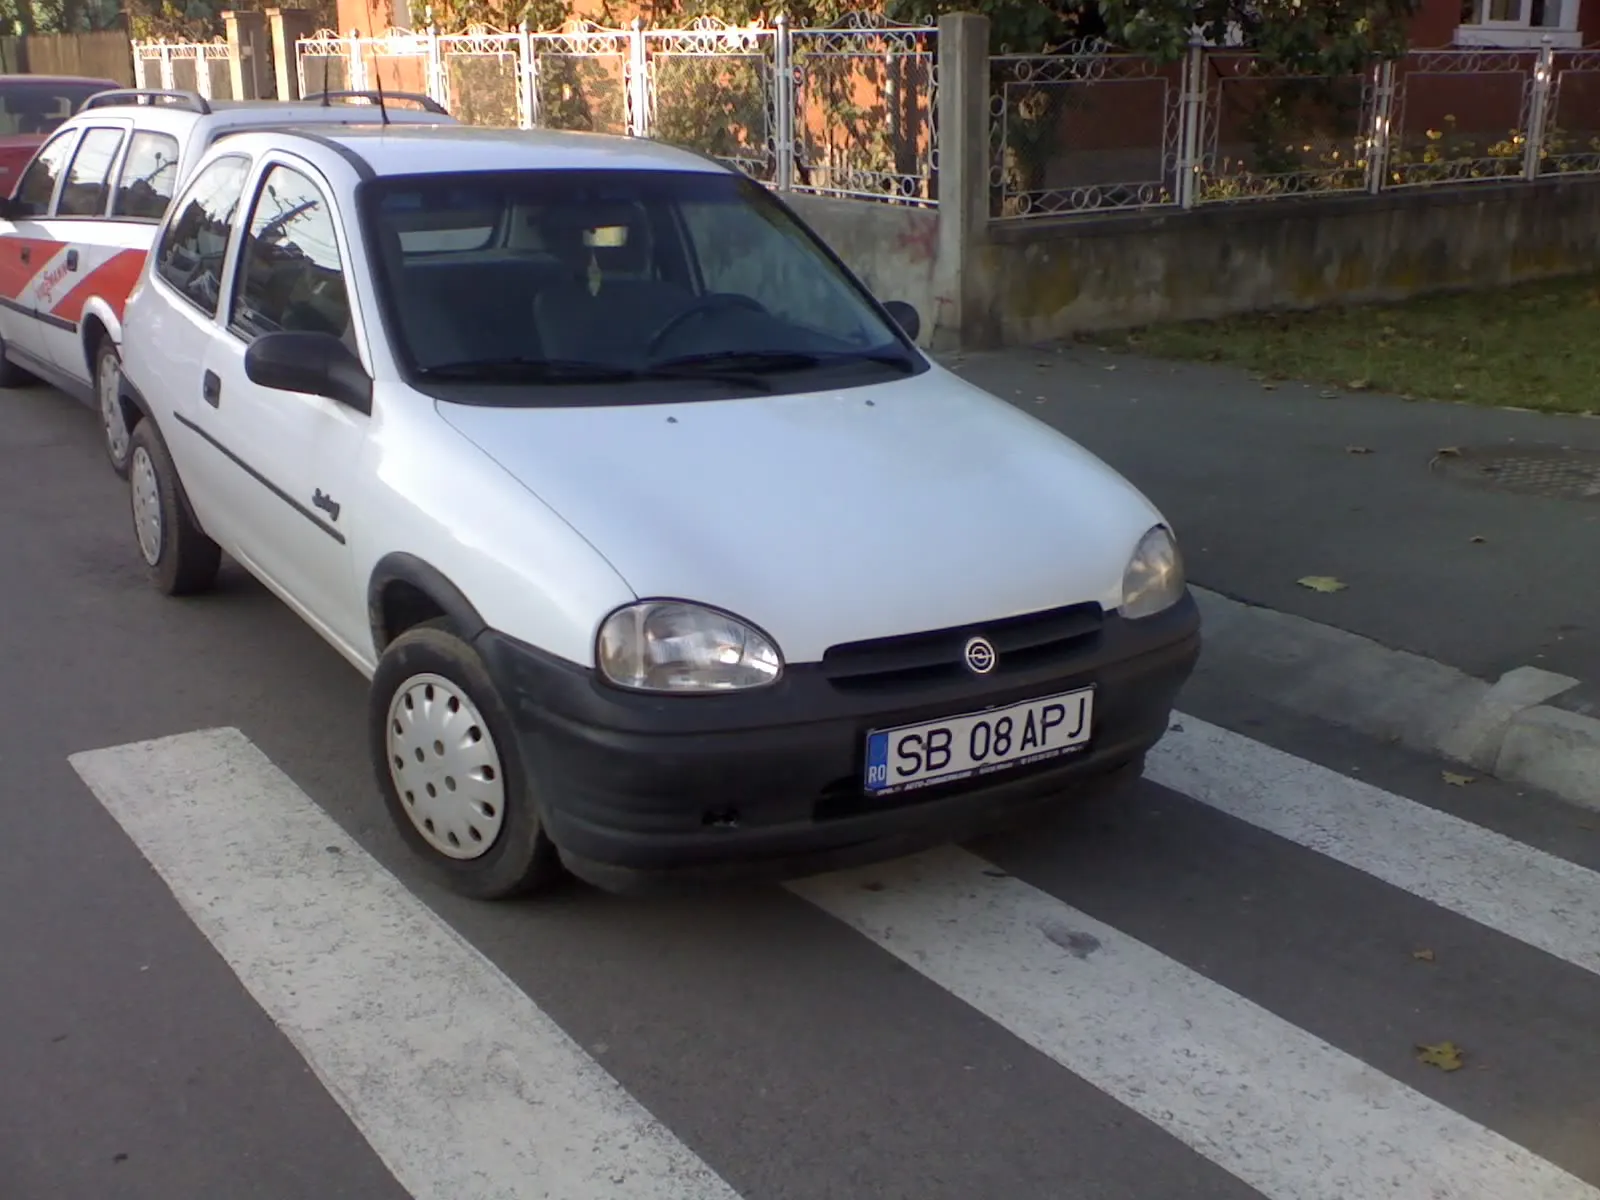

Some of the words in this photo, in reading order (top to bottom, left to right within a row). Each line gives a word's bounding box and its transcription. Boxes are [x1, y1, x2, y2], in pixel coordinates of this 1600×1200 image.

[896, 728, 952, 776] SB
[969, 716, 1013, 761] 08
[1020, 697, 1085, 751] APJ
[868, 764, 886, 784] RO
